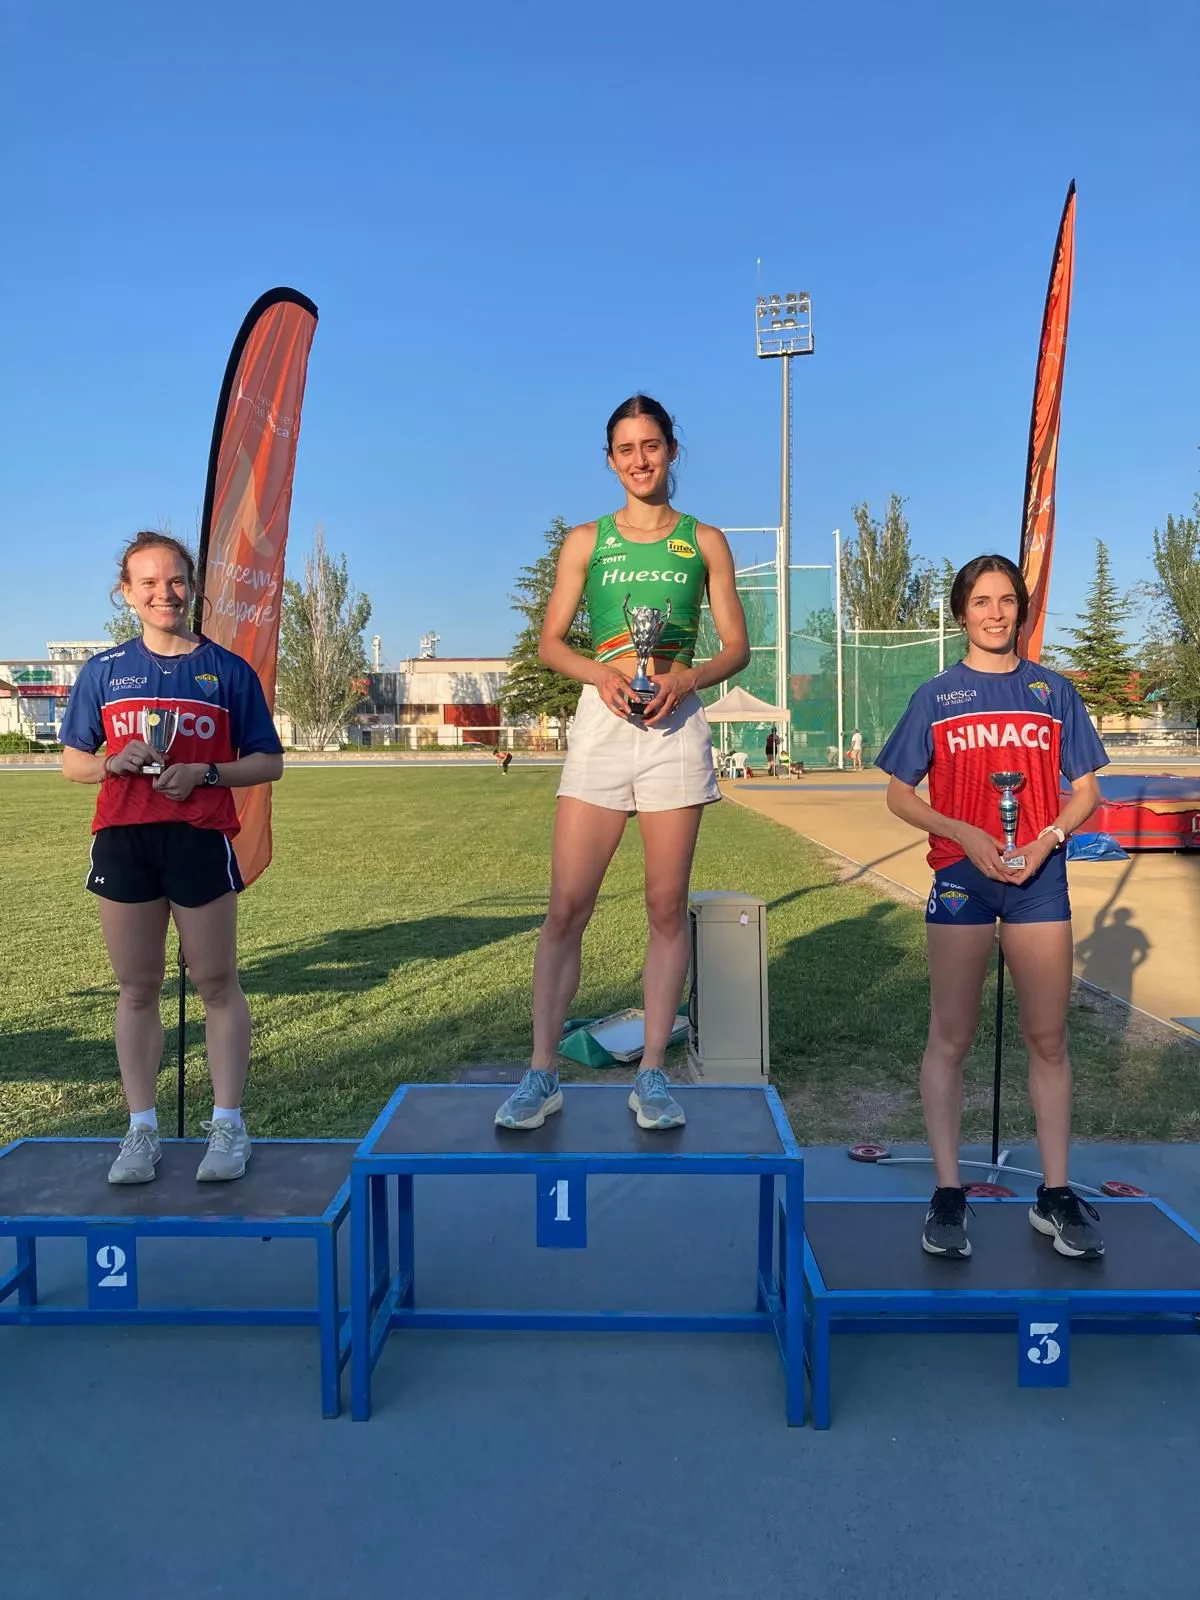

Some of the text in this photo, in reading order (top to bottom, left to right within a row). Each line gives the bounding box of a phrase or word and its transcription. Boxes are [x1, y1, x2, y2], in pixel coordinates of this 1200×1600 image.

[602, 568, 688, 586] Huesca
[110, 676, 148, 687] Huesca
[936, 689, 977, 703] Huesca
[111, 710, 216, 740] HICO
[549, 1179, 571, 1221] 1
[96, 1245, 128, 1287] 2
[1027, 1322, 1061, 1365] 3
